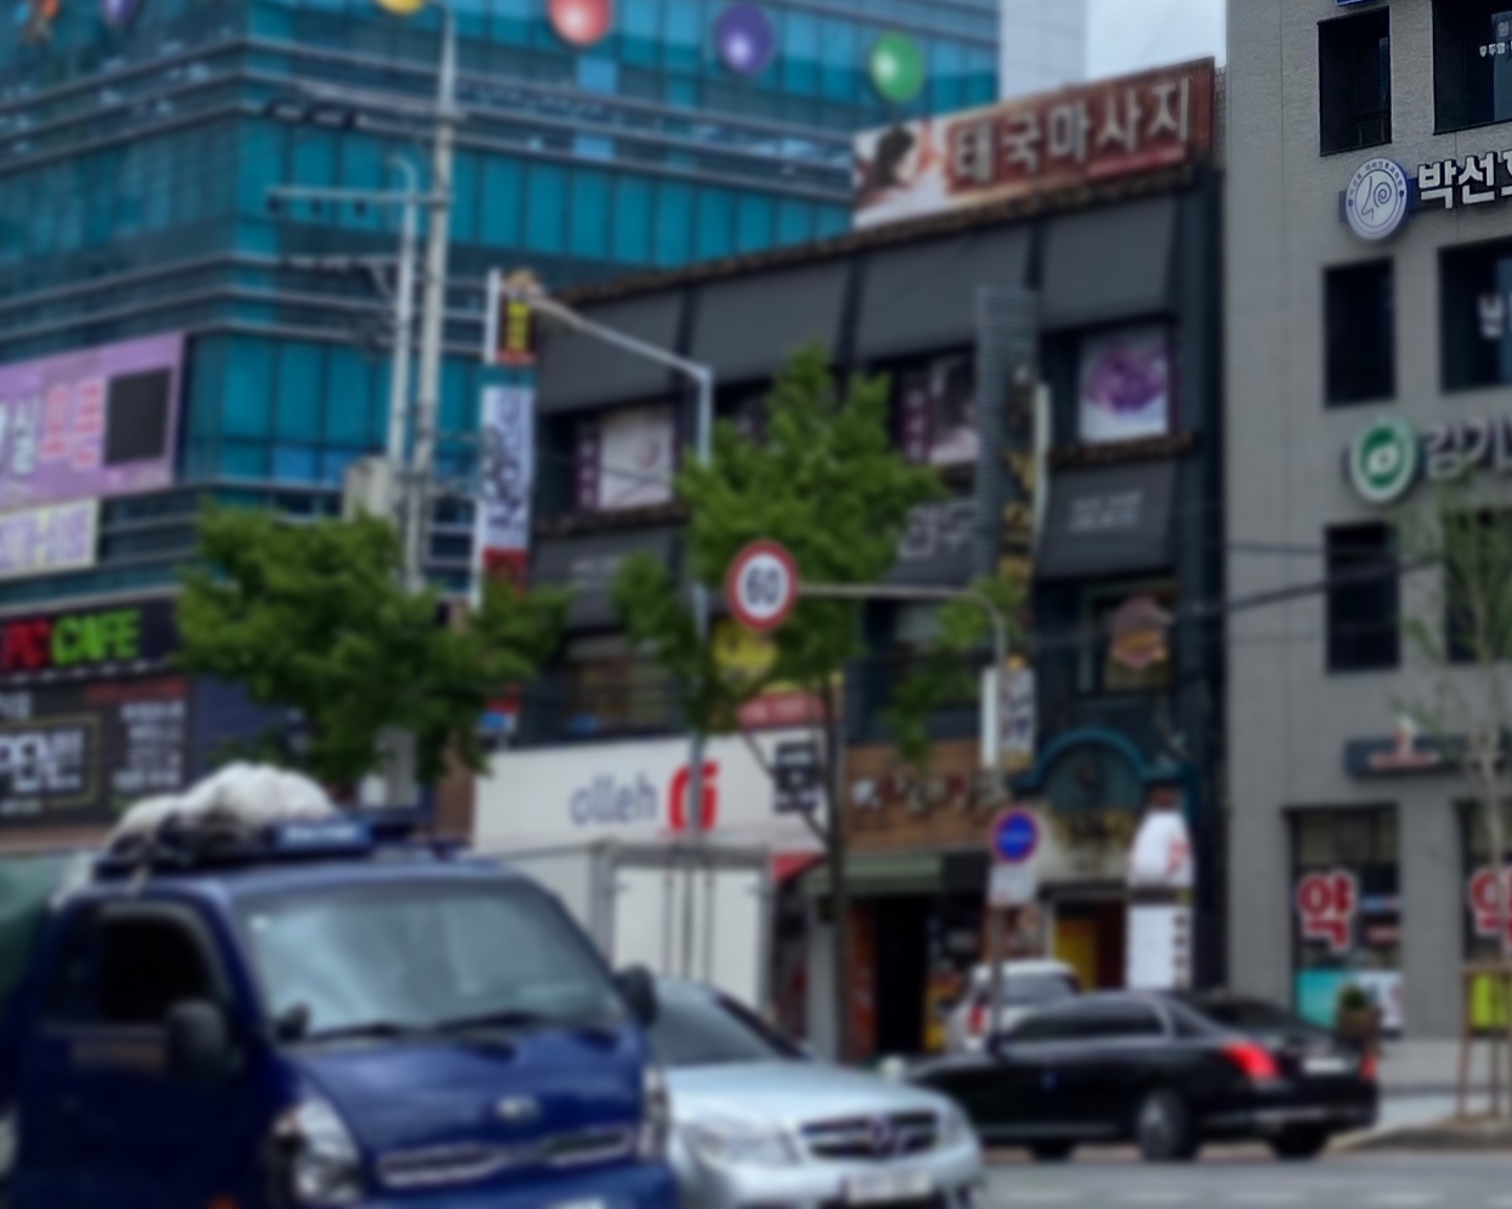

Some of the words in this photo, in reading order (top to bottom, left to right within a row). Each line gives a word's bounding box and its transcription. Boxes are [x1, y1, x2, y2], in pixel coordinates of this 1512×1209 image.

[954, 77, 1192, 184] 태국마사지
[745, 566, 780, 609] 60
[51, 609, 141, 666] CAFE
[1296, 867, 1356, 952] 약
